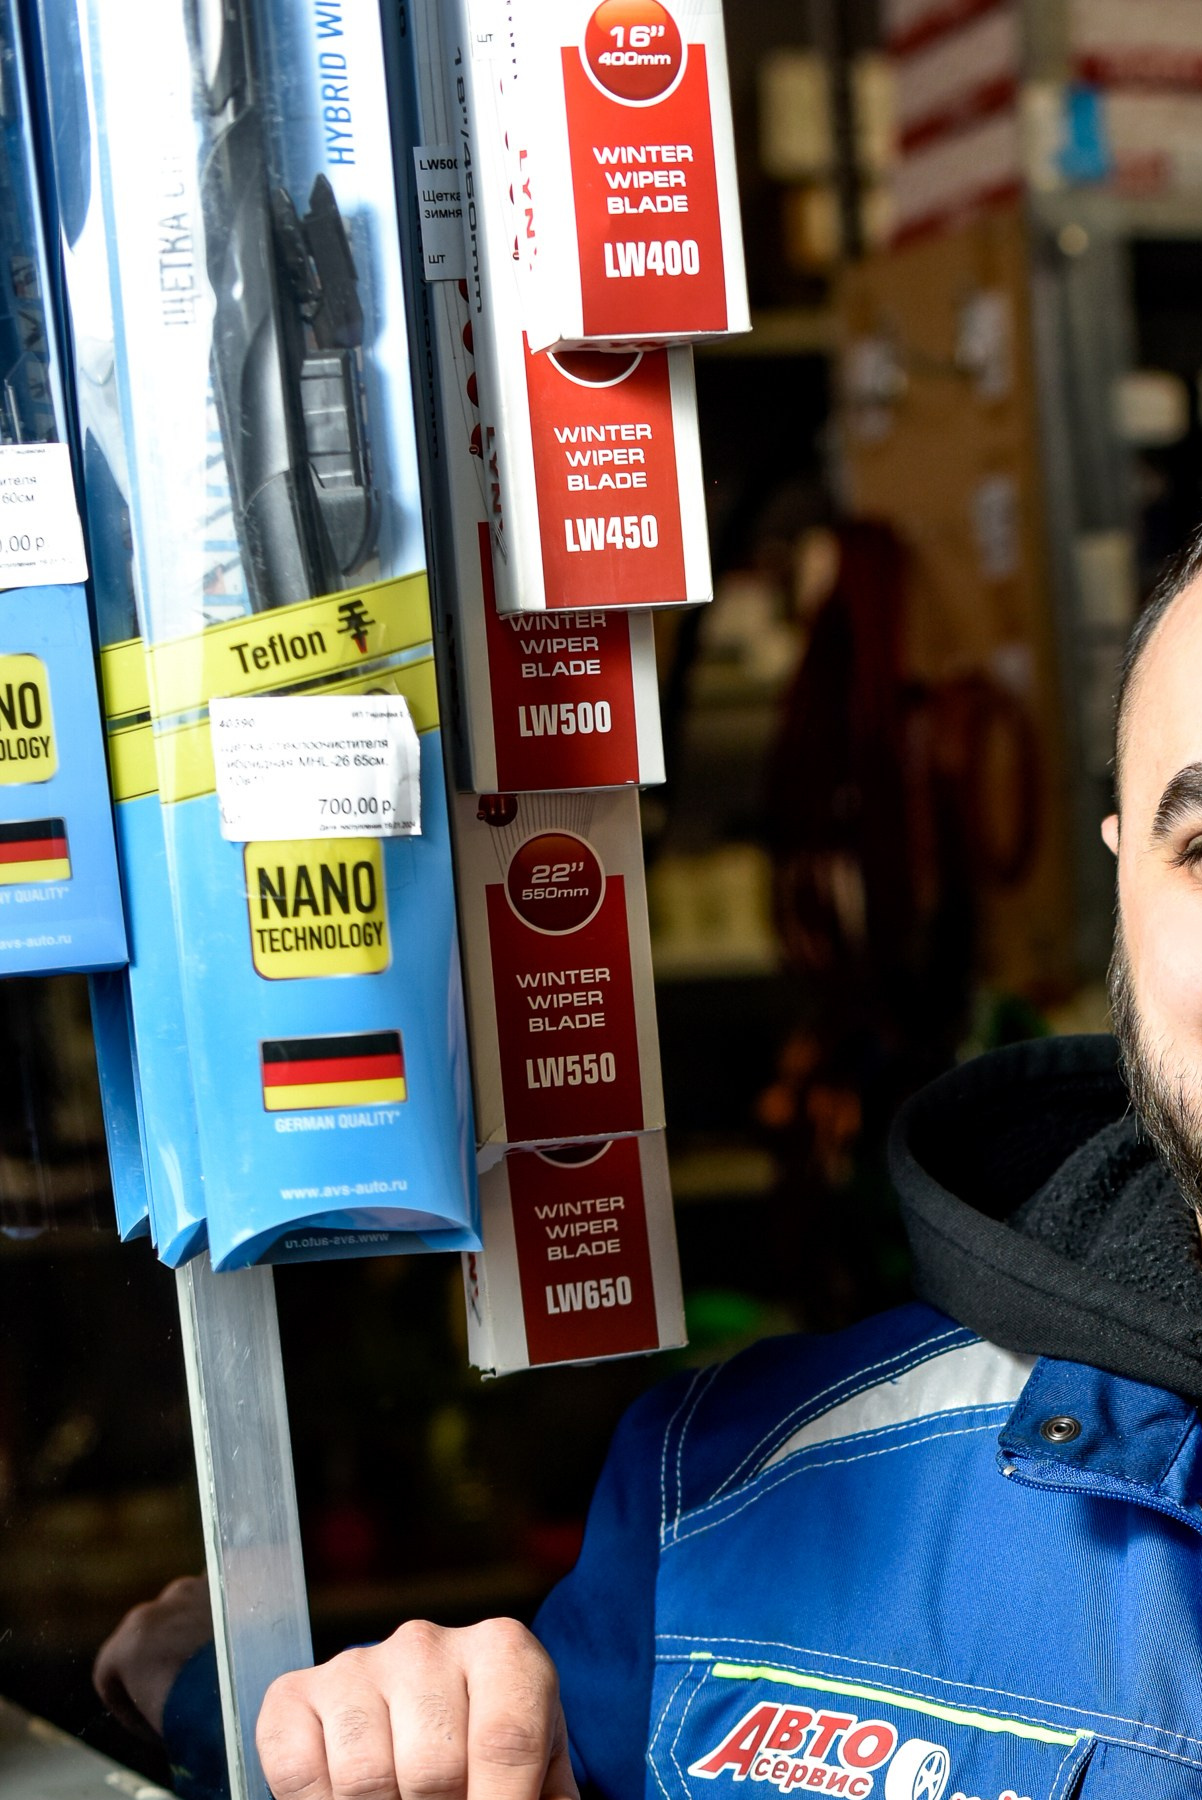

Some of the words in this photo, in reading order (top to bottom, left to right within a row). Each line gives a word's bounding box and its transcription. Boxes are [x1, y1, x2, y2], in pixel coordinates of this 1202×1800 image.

[598, 51, 671, 66] 400mm
[319, 53, 355, 165] HYBRID
[592, 145, 694, 164] WINTER
[605, 170, 686, 189] WIPER
[519, 149, 539, 272] LYN
[606, 195, 688, 214] BLADE
[604, 240, 700, 278] LW400
[159, 213, 203, 326] ЩЕТКА
[553, 424, 653, 444] WINTER
[565, 448, 645, 468] WIPER
[567, 472, 648, 491] BLADE
[564, 515, 659, 553] LW450
[511, 613, 607, 632] WINTER
[229, 628, 328, 674] Teflon
[520, 636, 599, 655] WIPER
[521, 660, 601, 678] BLADE
[518, 701, 612, 738] LW500
[318, 797, 378, 815] 700,00
[257, 860, 377, 919] NANO
[522, 886, 589, 900] 550mm
[256, 921, 384, 954] TECHNOLOGY
[516, 968, 611, 988] WINTER
[527, 991, 604, 1010] WIPER
[529, 1013, 606, 1032] BLADE
[526, 1052, 616, 1089] LW550
[275, 1116, 335, 1133] GERMAN
[280, 1180, 408, 1200] www.avs-auto.ru
[534, 1196, 625, 1220] WINTER
[545, 1218, 618, 1240] WIPER
[547, 1239, 621, 1261] BLADE
[545, 1276, 632, 1315] LW650
[698, 1706, 894, 1777] АВТО
[755, 1758, 869, 1797] сервис
